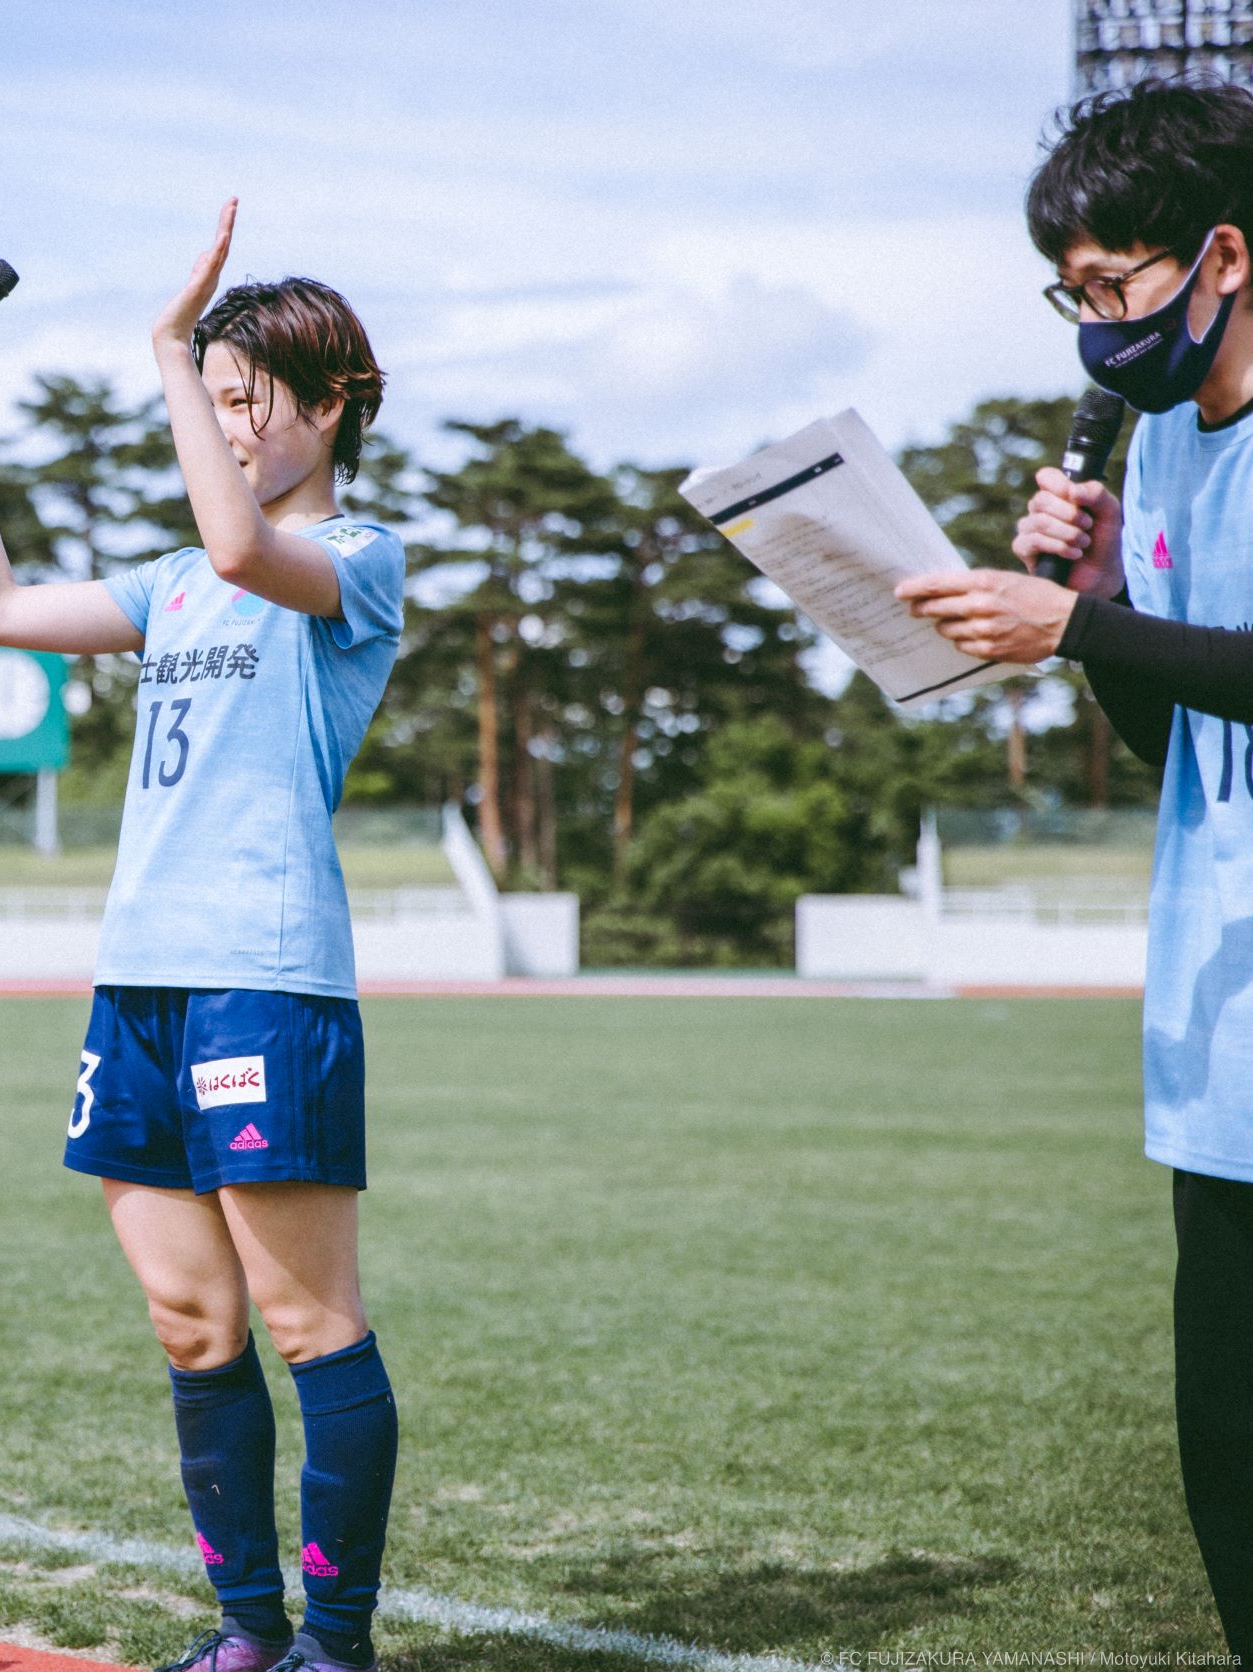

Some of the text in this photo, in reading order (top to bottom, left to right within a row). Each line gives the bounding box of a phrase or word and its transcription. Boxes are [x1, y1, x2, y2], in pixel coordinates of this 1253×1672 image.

[1105, 357, 1116, 367] FC
[1115, 331, 1161, 361] FUJIZAKURA
[143, 698, 192, 789] 13
[209, 1067, 260, 1092] はくばく
[229, 1139, 269, 1150] adidas
